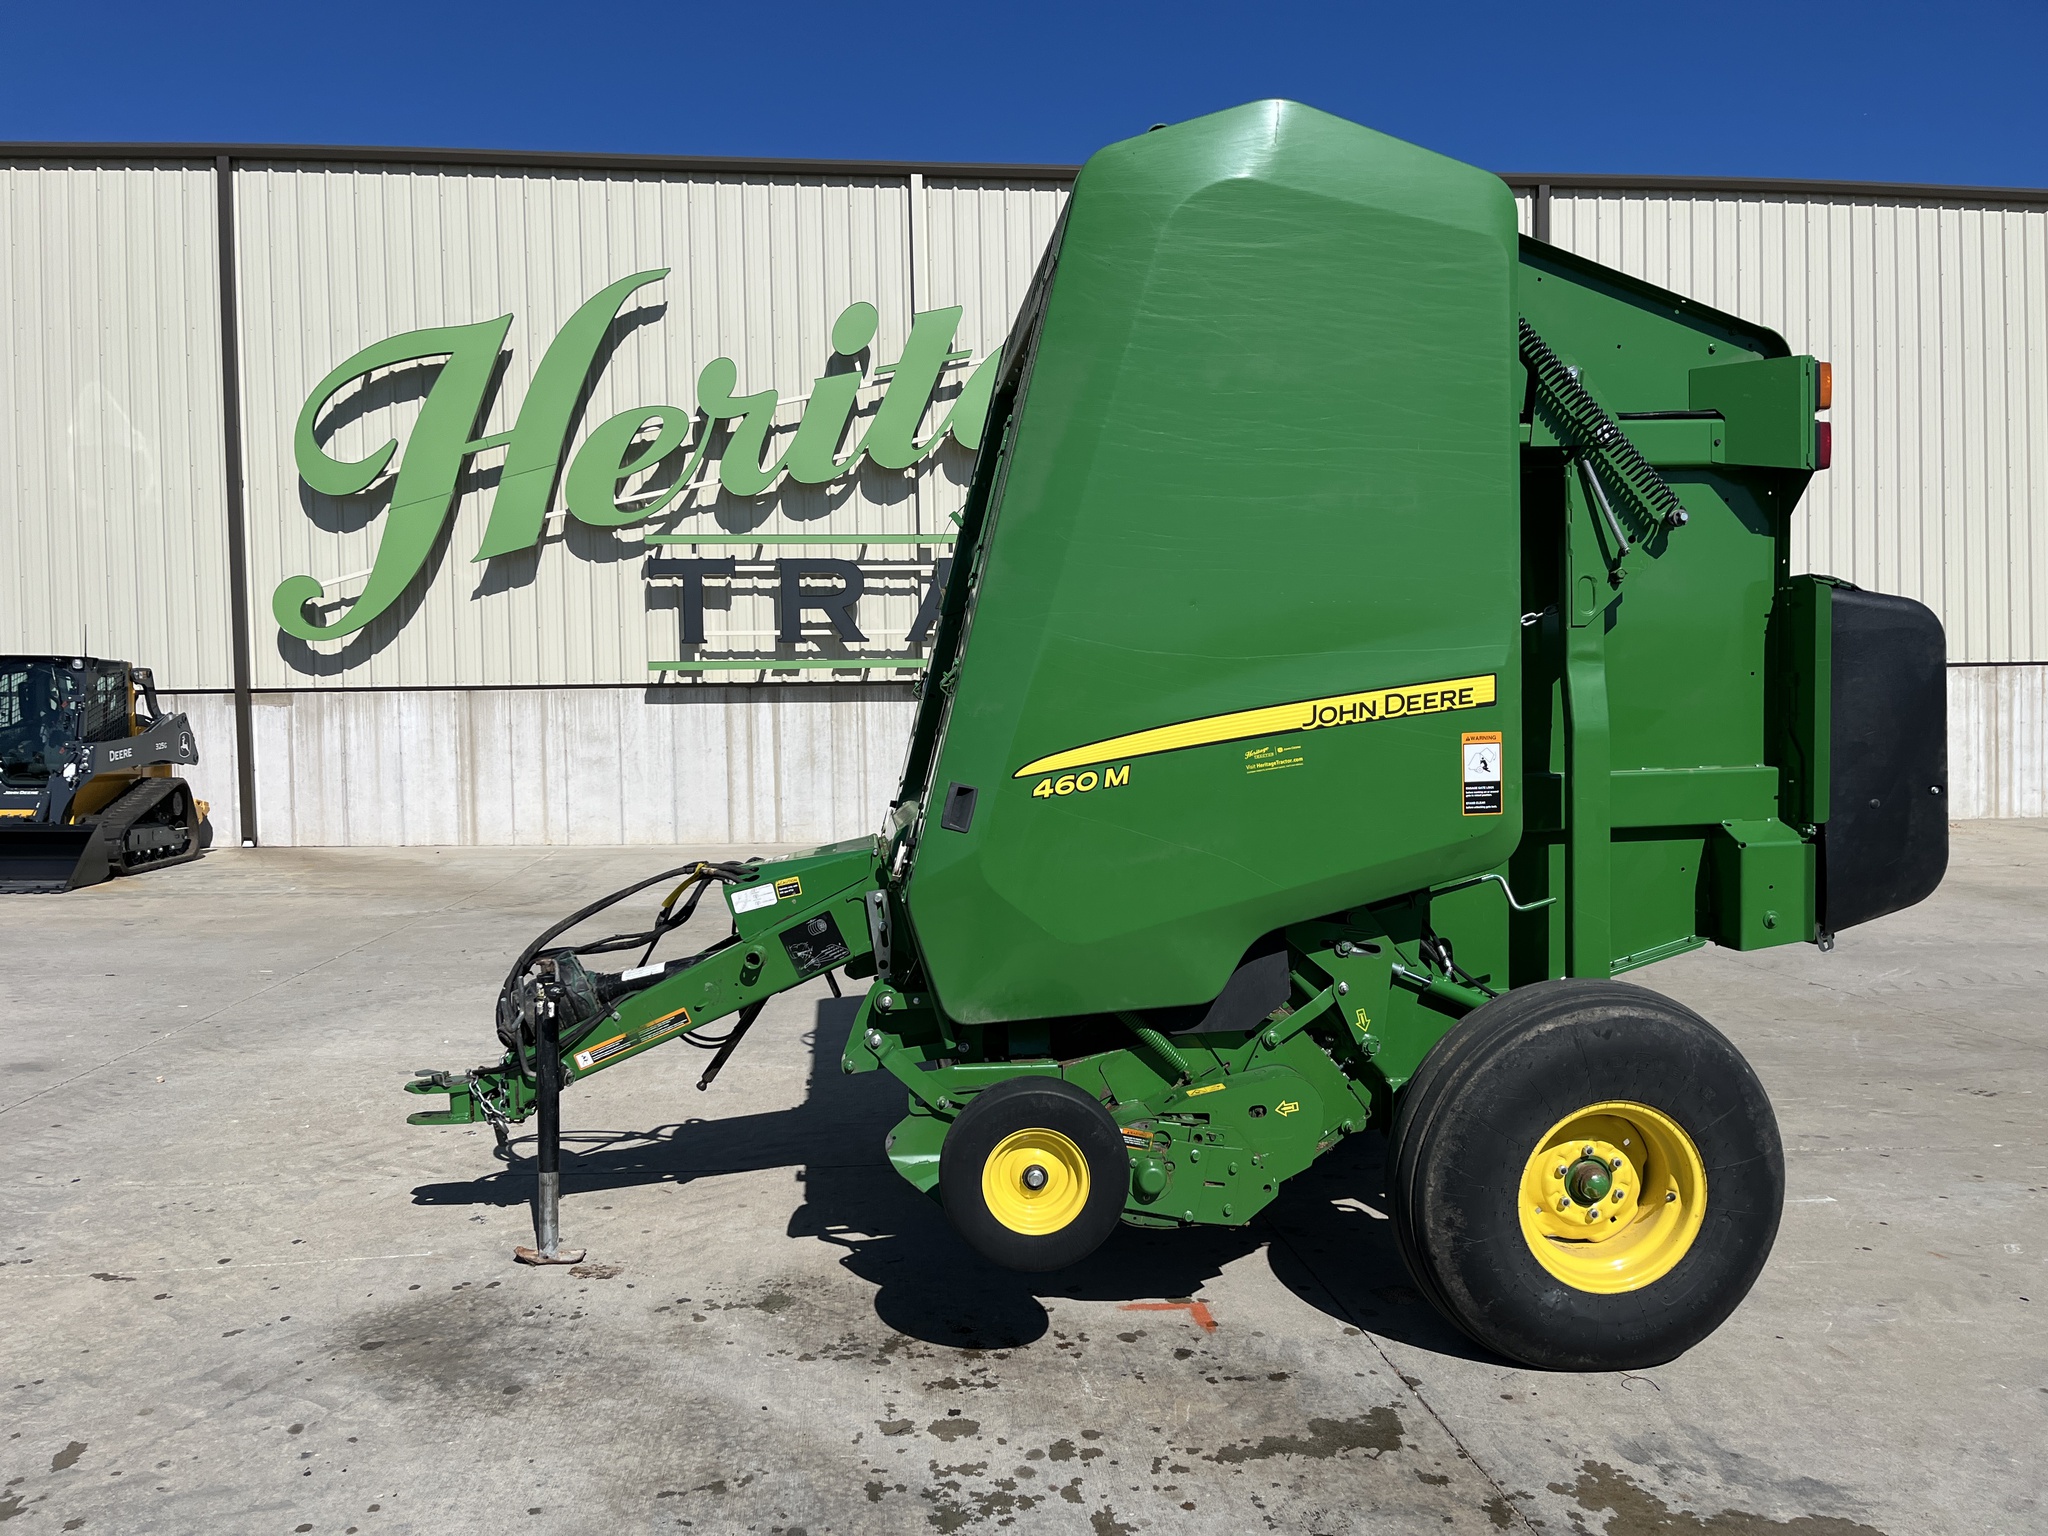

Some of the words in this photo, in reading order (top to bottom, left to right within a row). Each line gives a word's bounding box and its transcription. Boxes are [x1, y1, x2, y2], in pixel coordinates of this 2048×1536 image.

[1303, 699, 1377, 728] JOHN
[1383, 686, 1475, 716] DEERE
[109, 747, 133, 762] DEERE
[1032, 769, 1098, 799] 460
[1102, 764, 1131, 790] M
